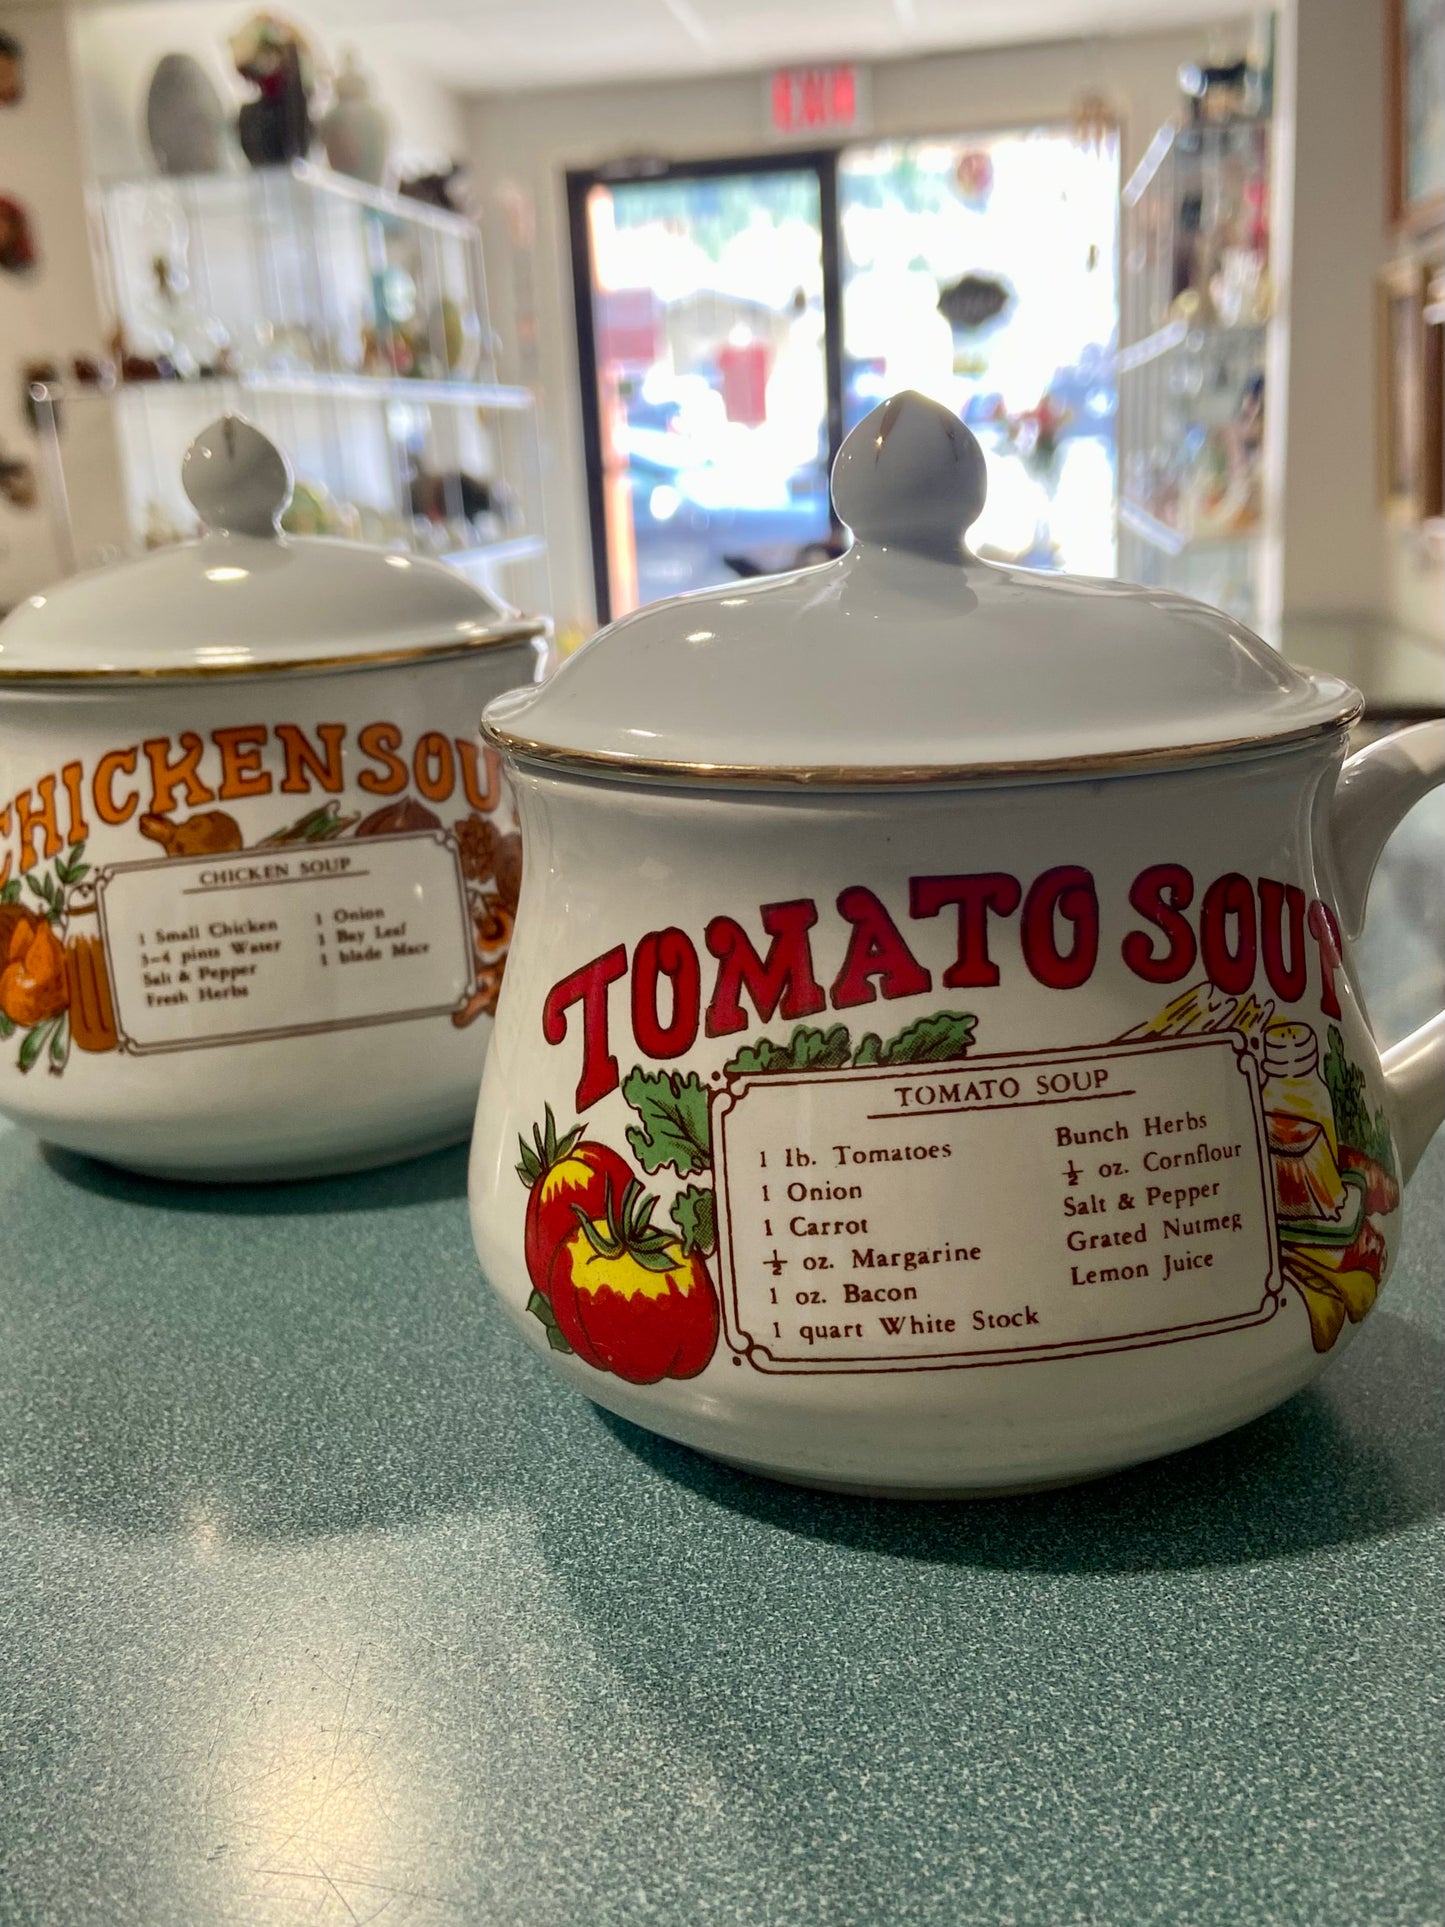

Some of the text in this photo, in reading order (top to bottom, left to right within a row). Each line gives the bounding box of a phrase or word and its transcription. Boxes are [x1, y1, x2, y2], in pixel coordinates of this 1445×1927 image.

[357, 721, 502, 814] SOU
[199, 856, 352, 886] CHICKEN SOUP
[333, 906, 386, 923] Onion
[155, 924, 200, 944] Small
[208, 918, 279, 939] Chicken
[336, 928, 365, 945] Bay
[374, 921, 407, 939] Leaf
[181, 945, 221, 967] pints
[230, 939, 282, 955] Water
[338, 945, 382, 964] blade
[143, 963, 257, 988] Salt & Pepper
[543, 864, 1102, 1114] TOMATO
[146, 984, 249, 1008] Fresh Herbs
[894, 1068, 1109, 1108] TOMATO SOUP
[1055, 1111, 1208, 1147] Bunch Herbs
[759, 1143, 952, 1168] 1 lb. Tomatoes
[1098, 1161, 1129, 1178] oz.
[1143, 1143, 1242, 1172] Cornflour
[762, 1180, 863, 1202] 1 Onion
[1063, 1181, 1220, 1217] Salt & Pepper
[764, 1216, 868, 1237] 1 Carrot
[1066, 1212, 1243, 1252] Grated Nutmeg
[802, 1254, 834, 1271] oz.
[851, 1242, 982, 1271] Margarine
[1070, 1250, 1214, 1286] Lemon Juice
[770, 1283, 918, 1305] 1 oz. Bacon
[773, 1305, 1040, 1345] 1 quart White Stock
